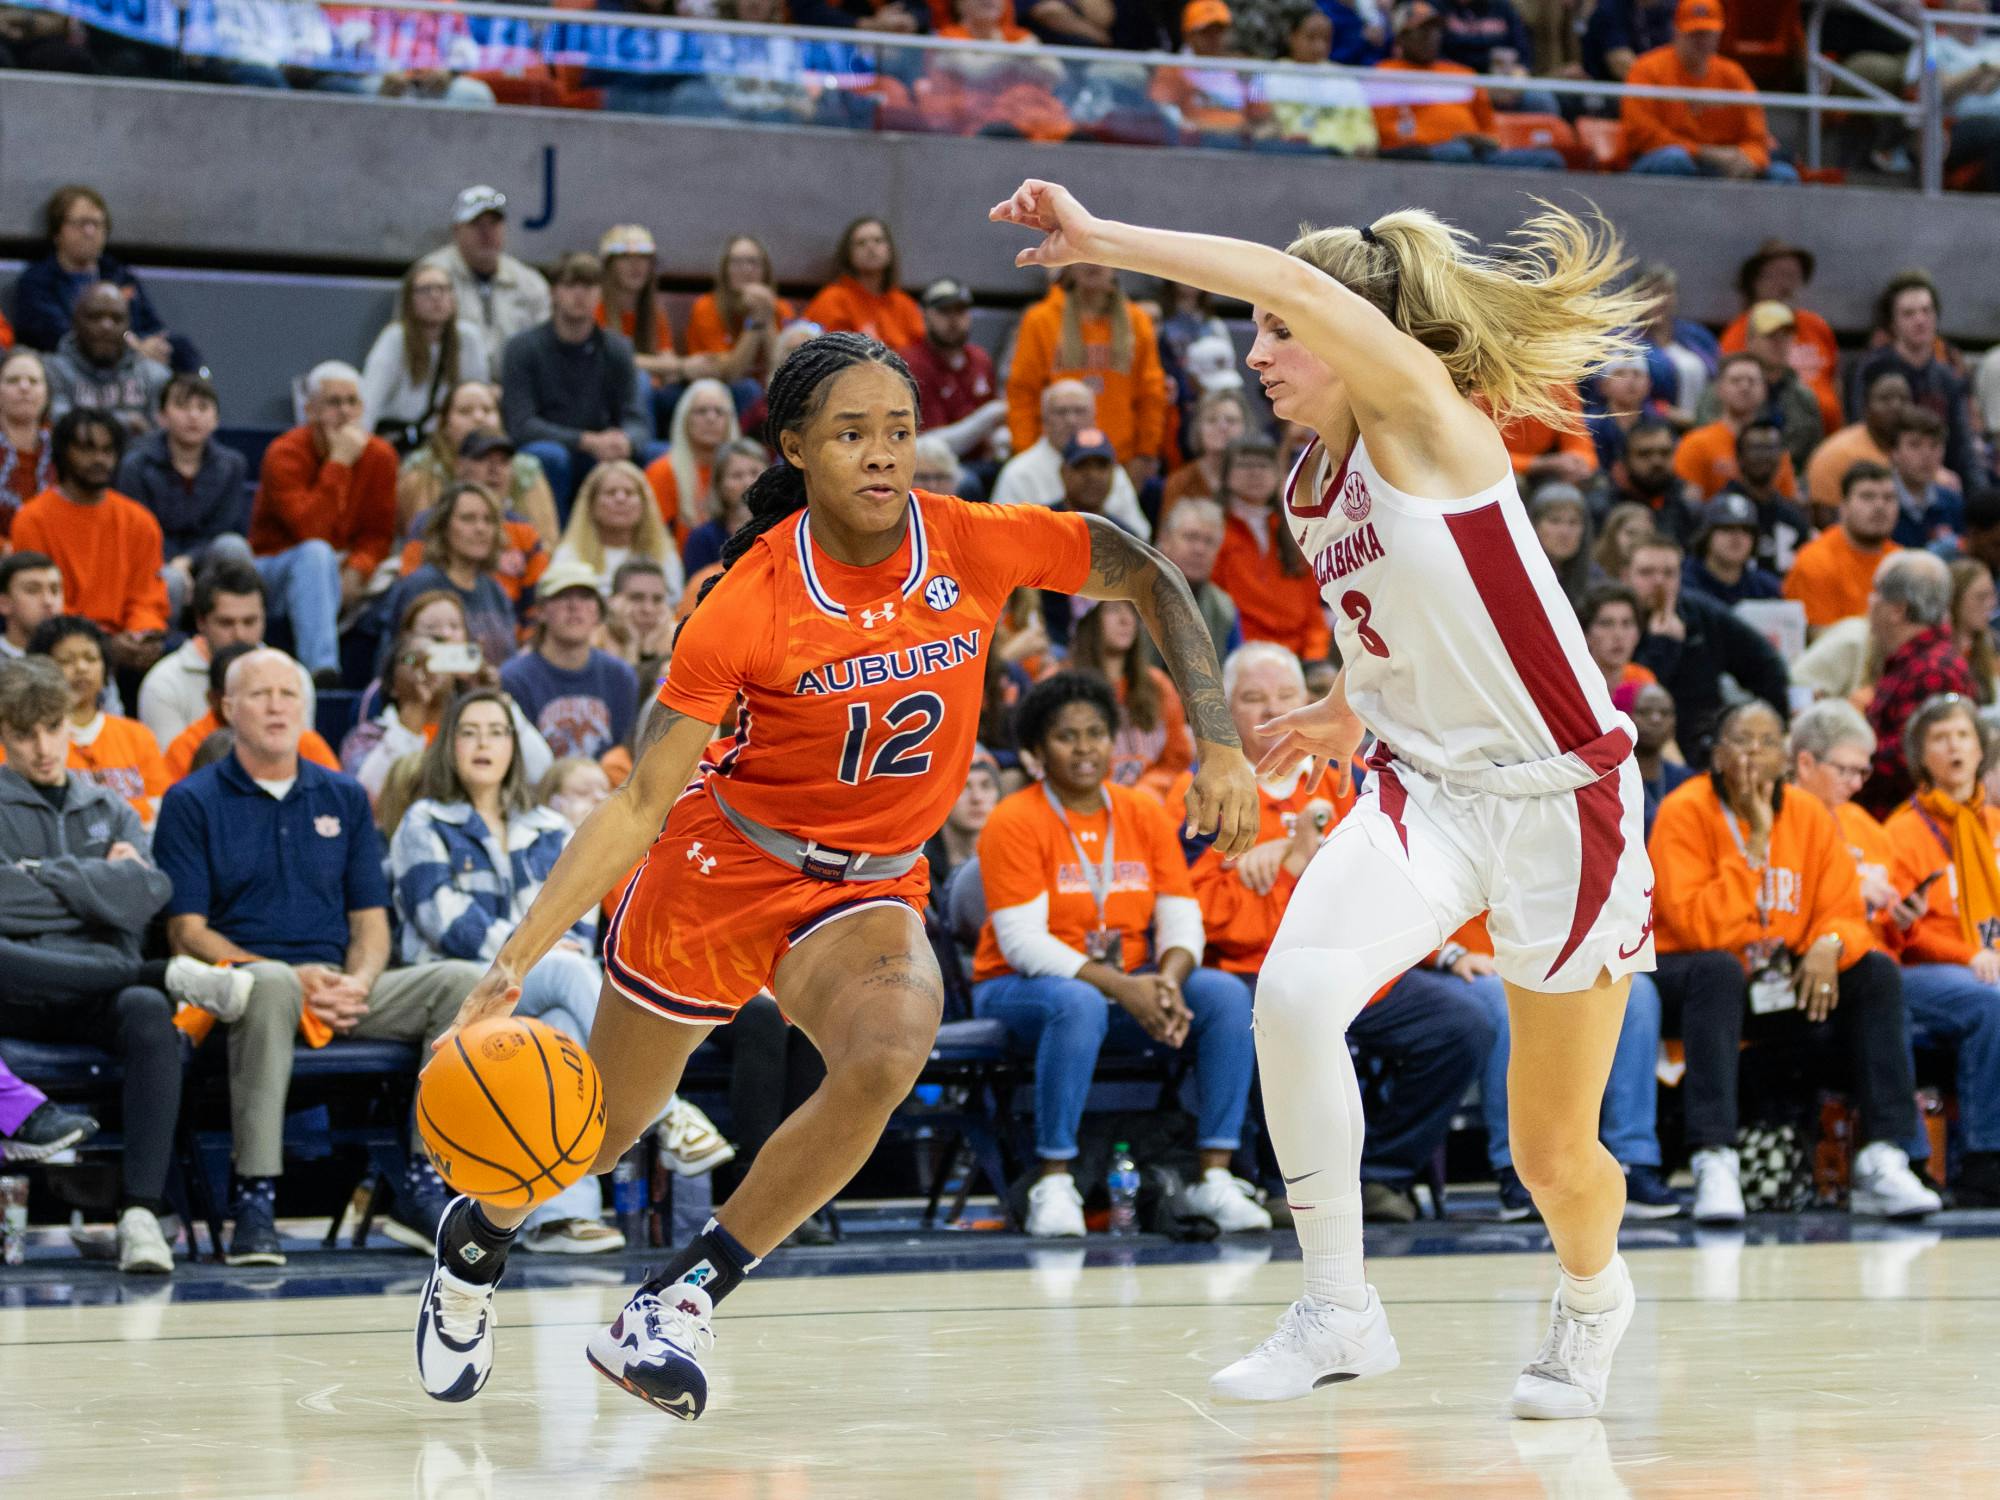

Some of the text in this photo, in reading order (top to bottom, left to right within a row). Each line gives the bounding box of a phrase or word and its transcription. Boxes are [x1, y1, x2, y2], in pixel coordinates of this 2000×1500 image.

[523, 145, 556, 230] J
[1345, 472, 1366, 509] SEC
[925, 576, 959, 611] SEC
[1341, 590, 1390, 658] 3
[794, 629, 981, 695] AUBURN
[837, 691, 945, 785] 12
